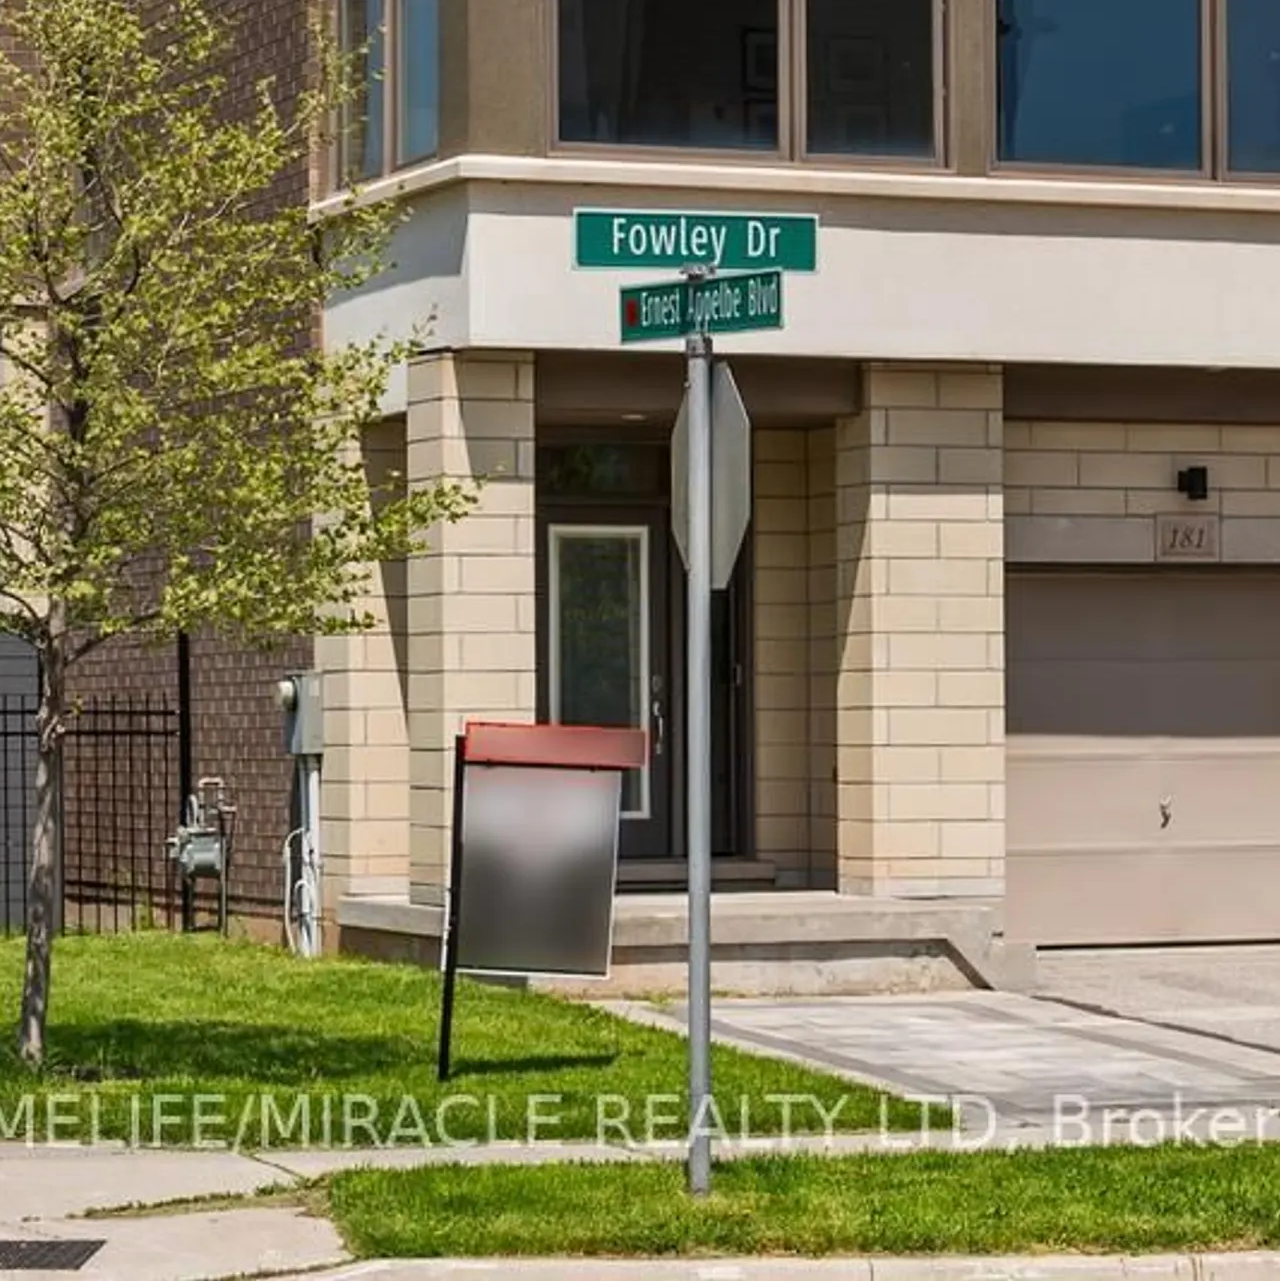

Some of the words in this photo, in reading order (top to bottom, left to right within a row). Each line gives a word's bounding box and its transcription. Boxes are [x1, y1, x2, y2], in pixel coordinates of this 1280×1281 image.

[613, 217, 726, 265] Fowley
[747, 220, 781, 257] Dr
[640, 289, 680, 326] Ernest
[686, 280, 741, 331] Appelbe
[748, 274, 778, 316] Blvd
[1169, 526, 1205, 549] 181
